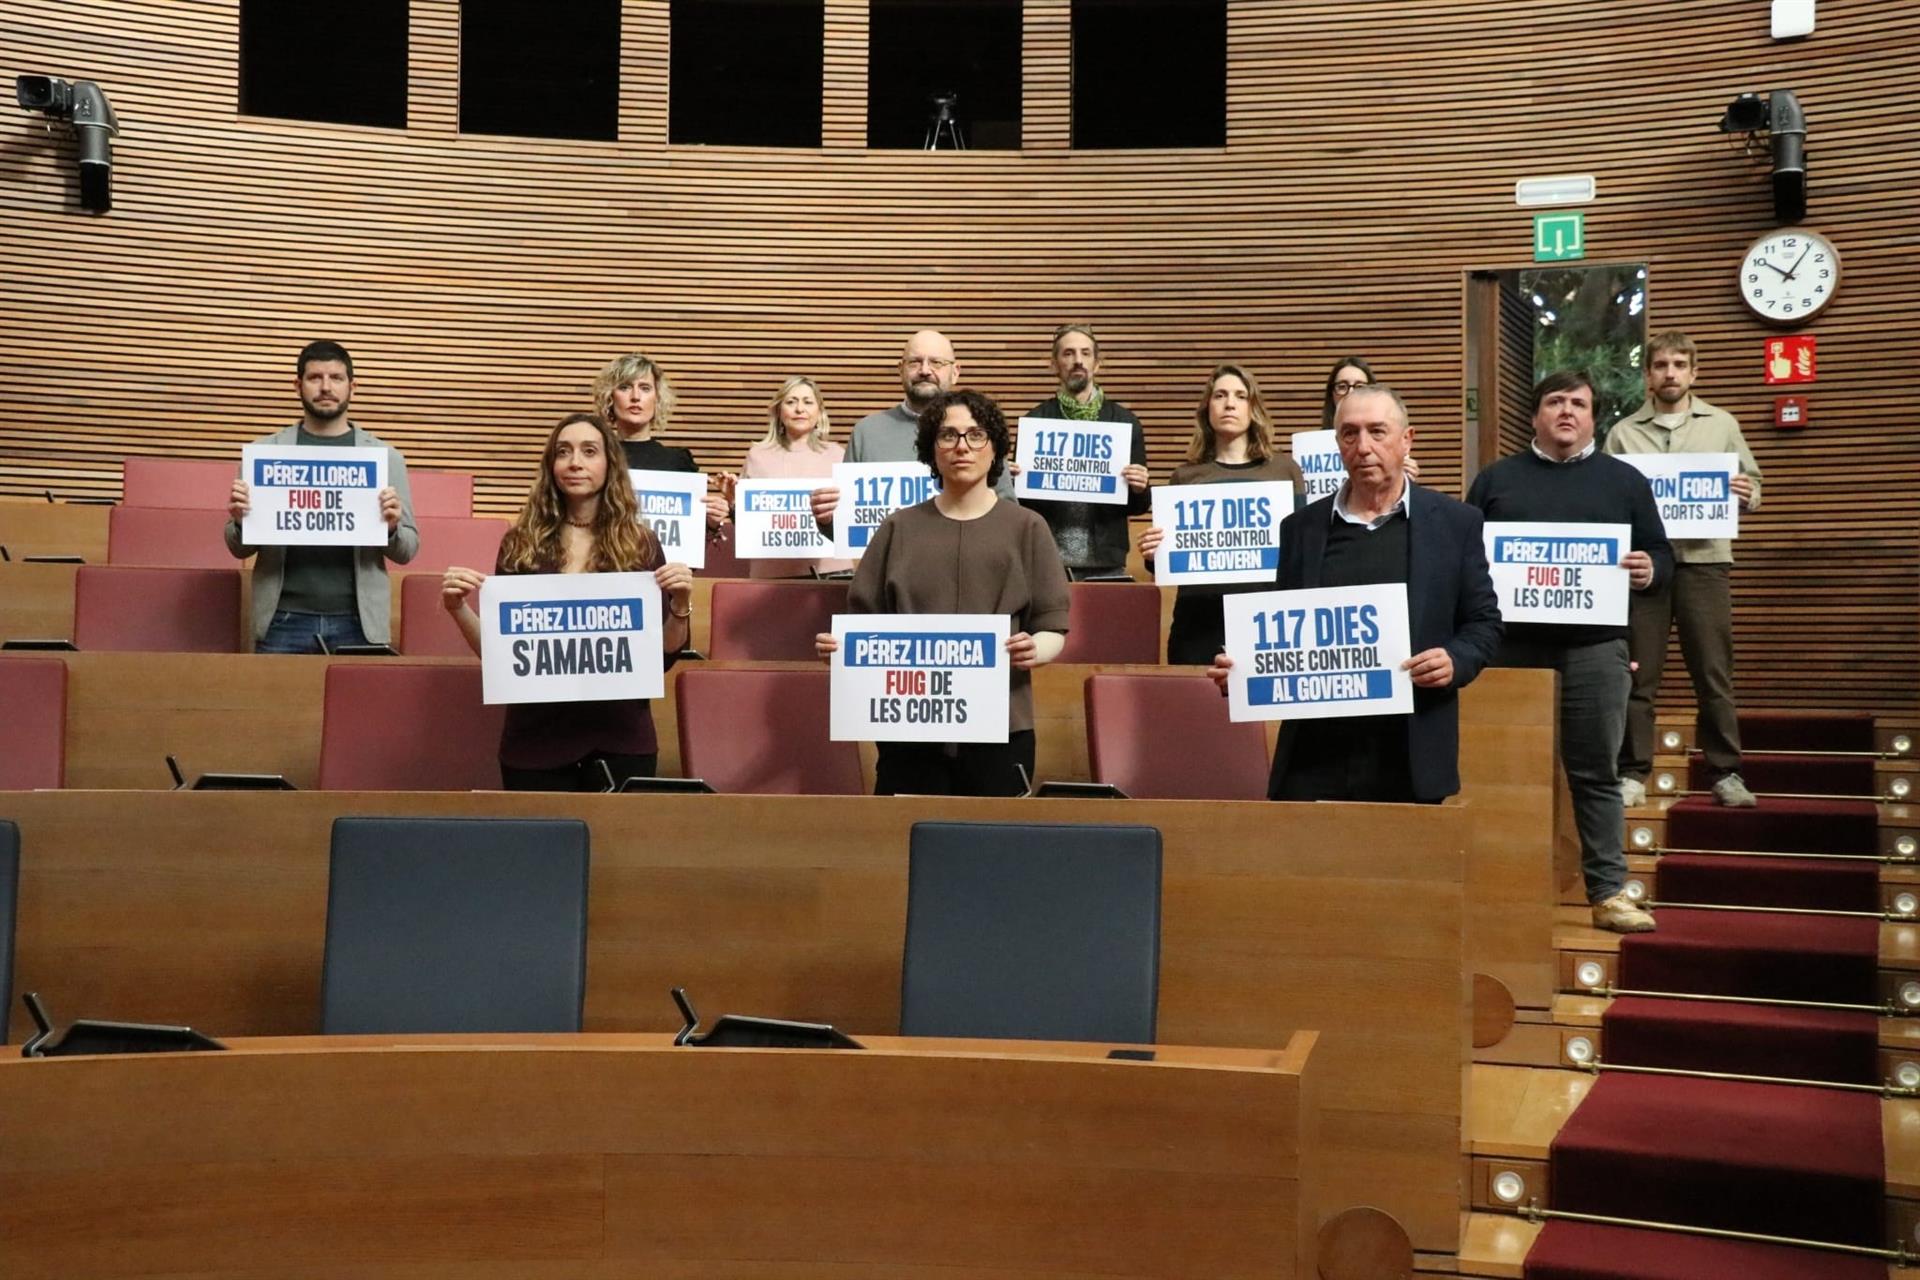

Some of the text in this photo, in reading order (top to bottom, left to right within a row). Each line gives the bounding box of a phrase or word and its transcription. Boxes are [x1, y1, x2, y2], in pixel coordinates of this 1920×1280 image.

[1764, 245, 1775, 254] 11
[1782, 239, 1797, 248] 12
[1753, 258, 1767, 267] 10
[1814, 253, 1824, 262] 2
[1748, 274, 1758, 283] 9
[1819, 269, 1829, 278] 3
[1753, 289, 1763, 298] 8
[1814, 285, 1824, 293] 4
[1766, 300, 1776, 309] 7
[1783, 303, 1793, 313] 6
[1801, 298, 1812, 307] 5
[1034, 431, 1113, 460] 117 DIES
[263, 461, 367, 487] PÉREZ LLORCA
[1033, 457, 1111, 474] SENSE CONTROL
[854, 477, 894, 506] 117
[1041, 474, 1101, 492] AL GOVERN
[1319, 478, 1338, 494] LES
[1682, 477, 1724, 499] FORA
[289, 490, 343, 509] FUIG DE
[635, 494, 683, 514] LORCA
[751, 490, 812, 511] PÉREZ LLO
[277, 511, 355, 531] LES CORTS
[772, 514, 814, 529] FUIG DE
[1174, 497, 1272, 531] 117 DIES
[1663, 504, 1729, 520] CORTS JA!
[762, 531, 824, 547] LES CORTS
[1175, 530, 1273, 549] SENSE CONTROL
[1188, 549, 1262, 571] AL GOVERN
[1502, 538, 1609, 564] PÉREZ LLORCA
[1528, 567, 1582, 587] FUIG DE
[1514, 588, 1594, 609] LES CORTS
[510, 604, 633, 633] PÉREZ LLORCA
[1253, 604, 1380, 650] 117 DIES
[512, 637, 633, 677] S'AMAGA
[855, 634, 984, 666] PÉREZ LLORCA
[1255, 647, 1382, 674] SENSE CONTROL
[886, 670, 953, 695] FUIG DE
[1272, 673, 1368, 703] AL GOVERN
[870, 698, 968, 723] LES CORTS
